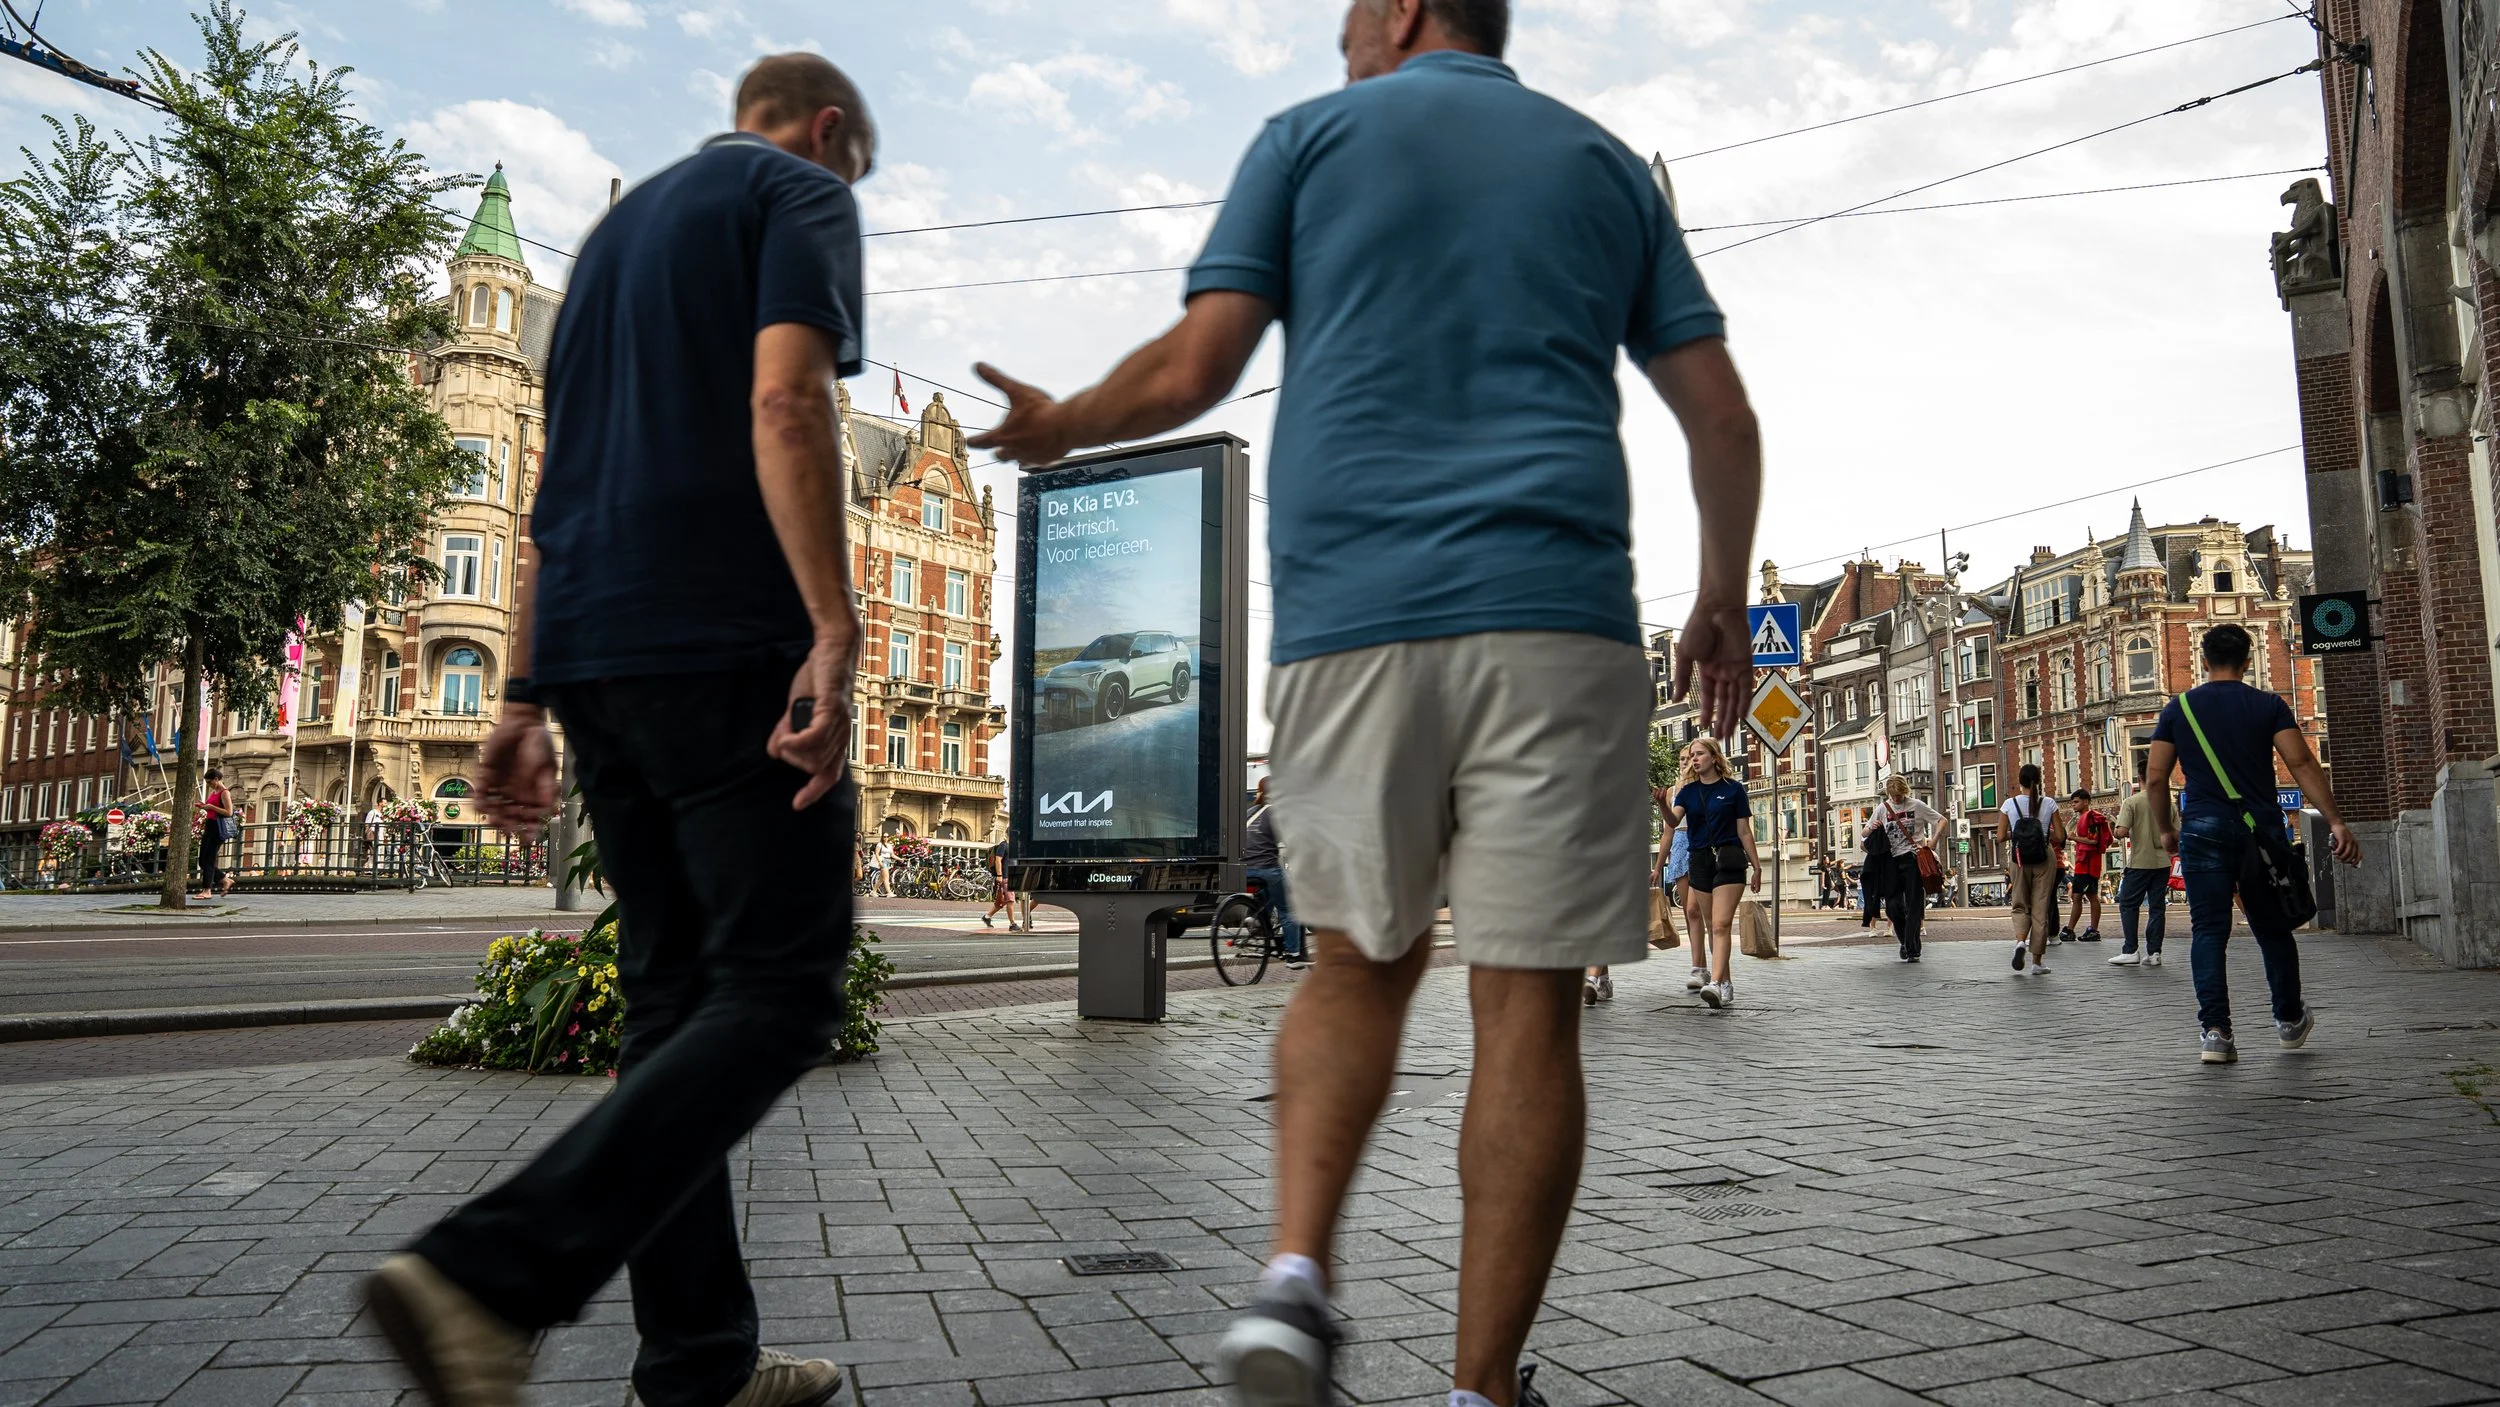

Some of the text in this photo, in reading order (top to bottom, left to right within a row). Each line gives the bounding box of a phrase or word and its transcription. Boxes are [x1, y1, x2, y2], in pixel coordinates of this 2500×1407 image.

[1047, 489, 1139, 518] De Kia EV3.
[1047, 516, 1119, 541] Elektrisch.
[1046, 538, 1153, 564] Voor iedereen.
[2312, 638, 2361, 651] oogwereld
[1040, 790, 1113, 814] KIA
[1040, 818, 1113, 828] Movement that inspires
[1087, 873, 1133, 883] JCDecaux
